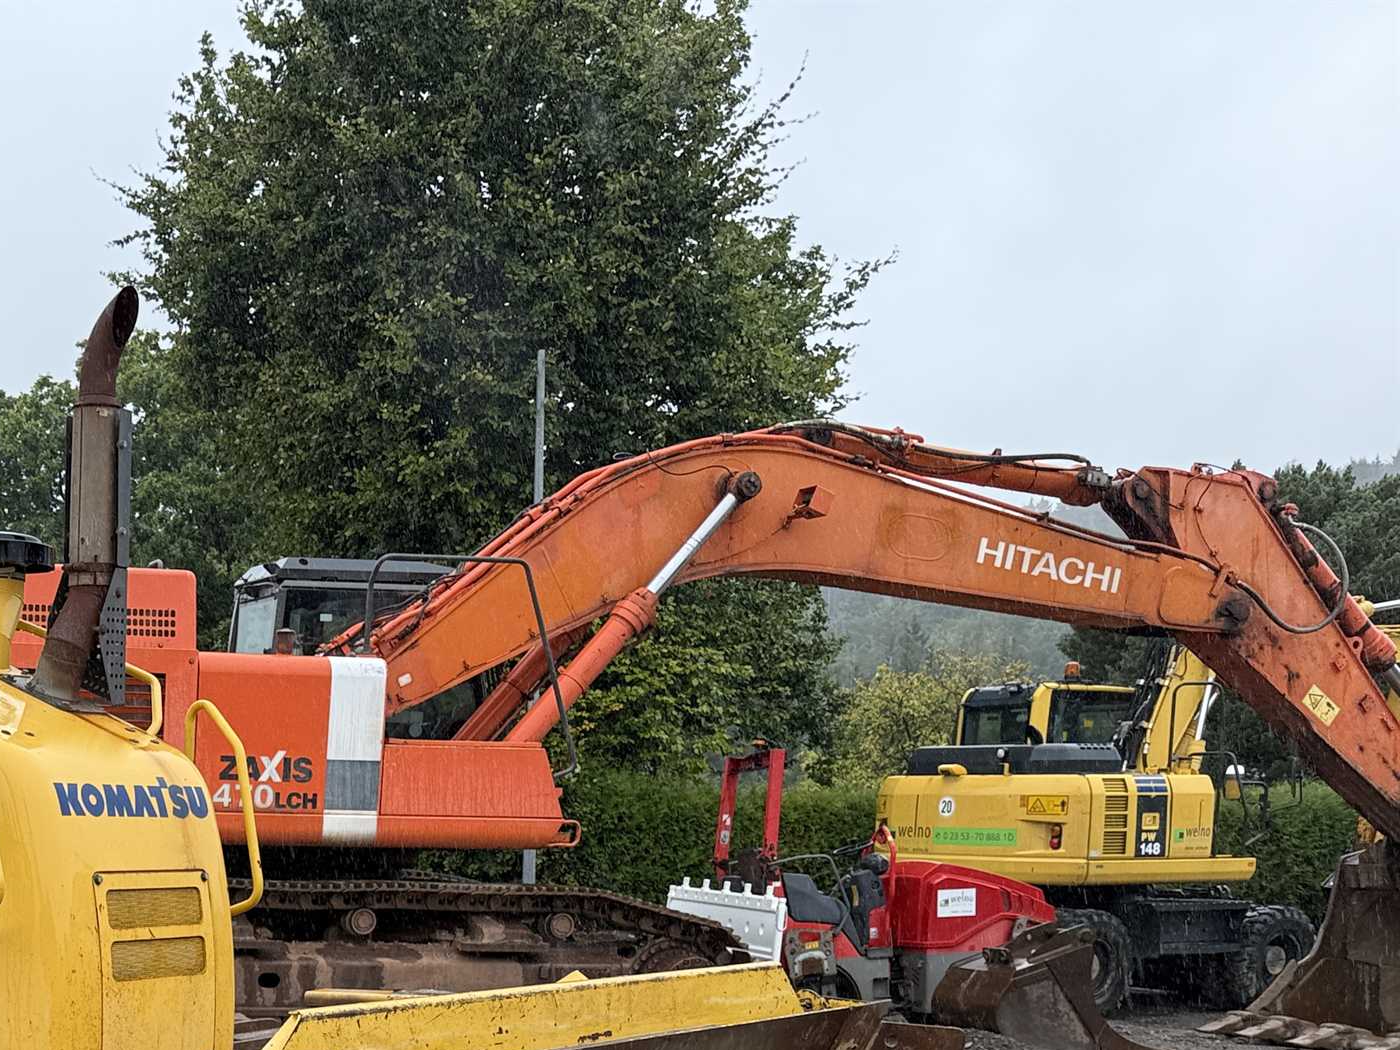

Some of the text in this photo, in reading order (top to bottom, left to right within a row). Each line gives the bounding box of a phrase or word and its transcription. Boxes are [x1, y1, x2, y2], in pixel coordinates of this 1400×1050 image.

[976, 537, 1122, 593] HITACHI
[218, 750, 313, 783] ZAXIS
[53, 776, 209, 819] KOMATSU
[941, 800, 952, 814] 20
[1140, 842, 1161, 855] 148
[1141, 832, 1157, 842] PW
